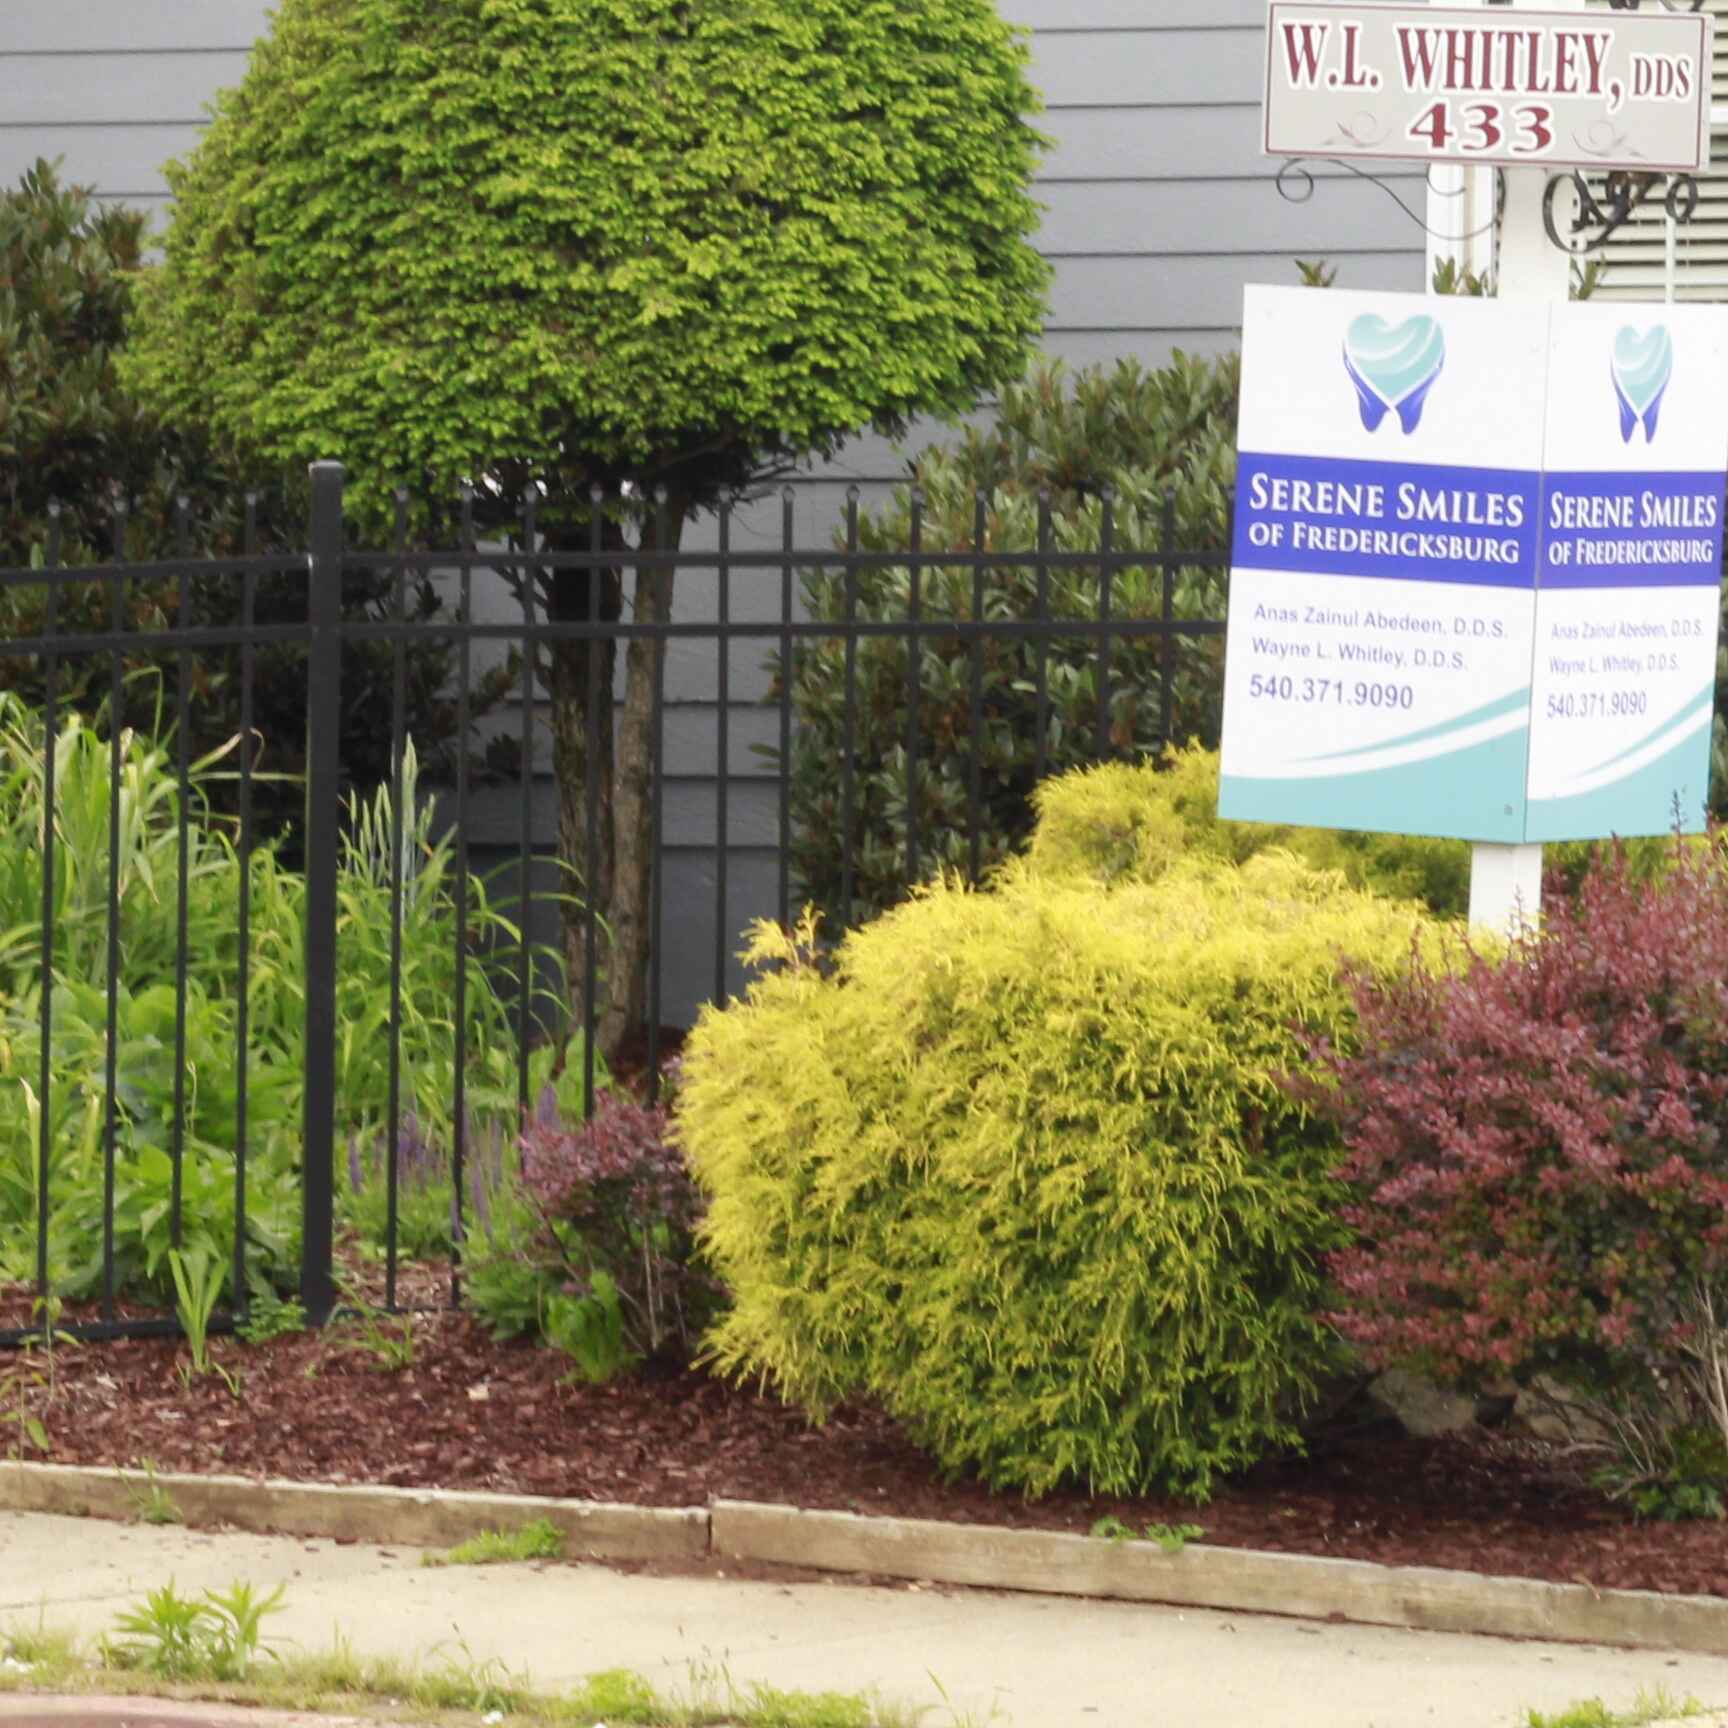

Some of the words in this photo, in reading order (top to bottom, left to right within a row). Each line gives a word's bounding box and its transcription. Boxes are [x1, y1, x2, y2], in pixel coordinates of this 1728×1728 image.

[1283, 24, 1379, 87] W.L.
[1397, 28, 1620, 109] WHITLEY,
[1634, 57, 1691, 97] DDS
[1410, 103, 1551, 153] 433
[1249, 472, 1385, 518] SERENE
[1396, 482, 1524, 527] SMILES
[1550, 491, 1635, 529] SERENE
[1640, 490, 1717, 528] SMILES
[1292, 522, 1520, 564] FREDERICKSBURG
[1576, 538, 1714, 566] FREDERICKSBURG
[1254, 604, 1298, 623] Anas
[1304, 606, 1358, 628] Zainul
[1454, 617, 1508, 638] D.D.S.
[1252, 637, 1311, 661] Wayne
[1414, 649, 1468, 670] D.D.S.
[1249, 674, 1413, 709] 540.371.9090
[1547, 690, 1647, 718] 540.371.9090
